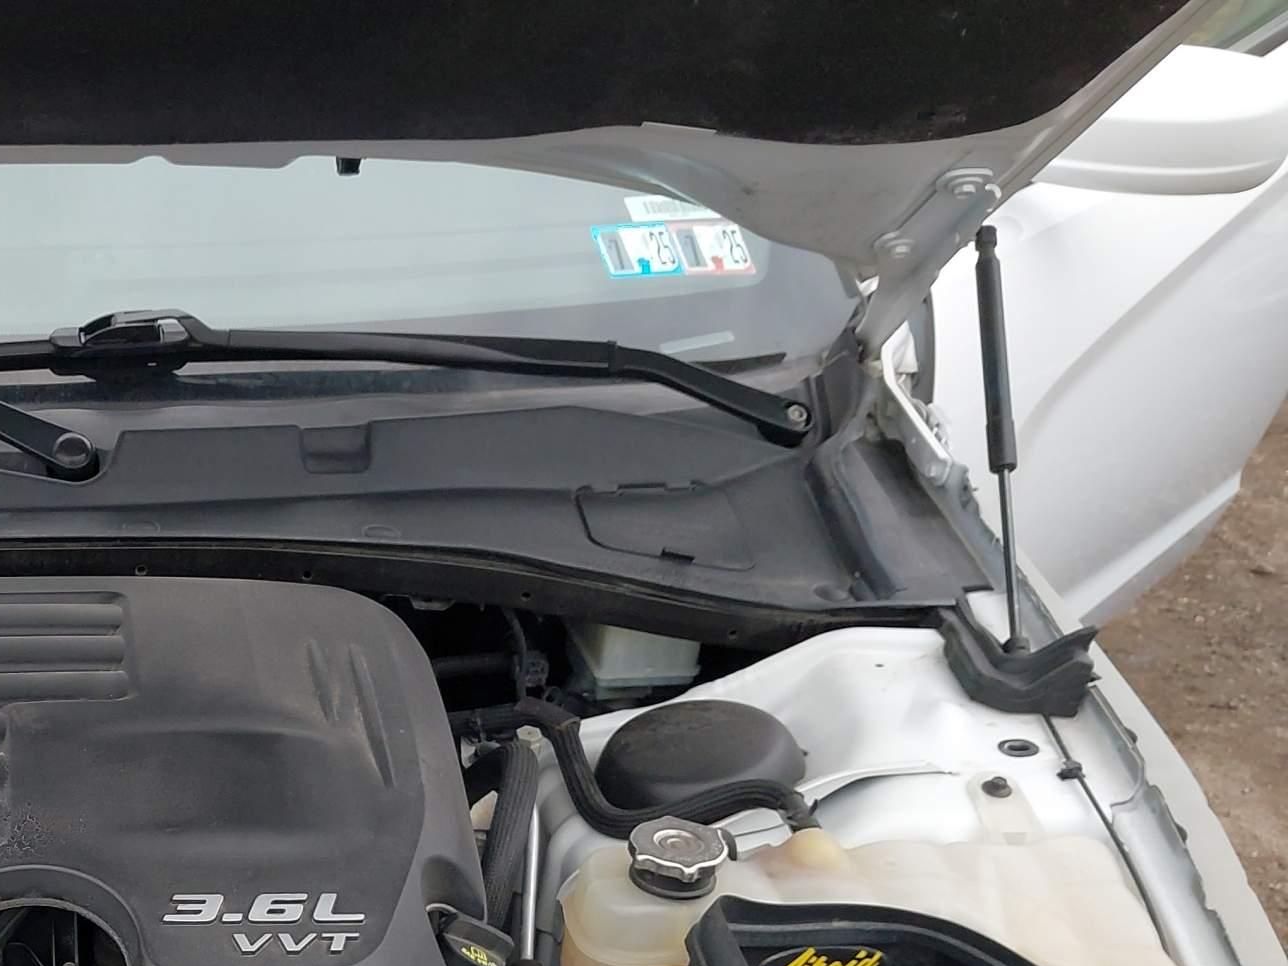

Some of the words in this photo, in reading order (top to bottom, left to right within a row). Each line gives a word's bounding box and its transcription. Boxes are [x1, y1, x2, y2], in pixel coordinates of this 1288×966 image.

[649, 231, 676, 265] 25
[721, 229, 749, 264] 25
[162, 892, 366, 923] 3.6L
[231, 932, 360, 954] VVT
